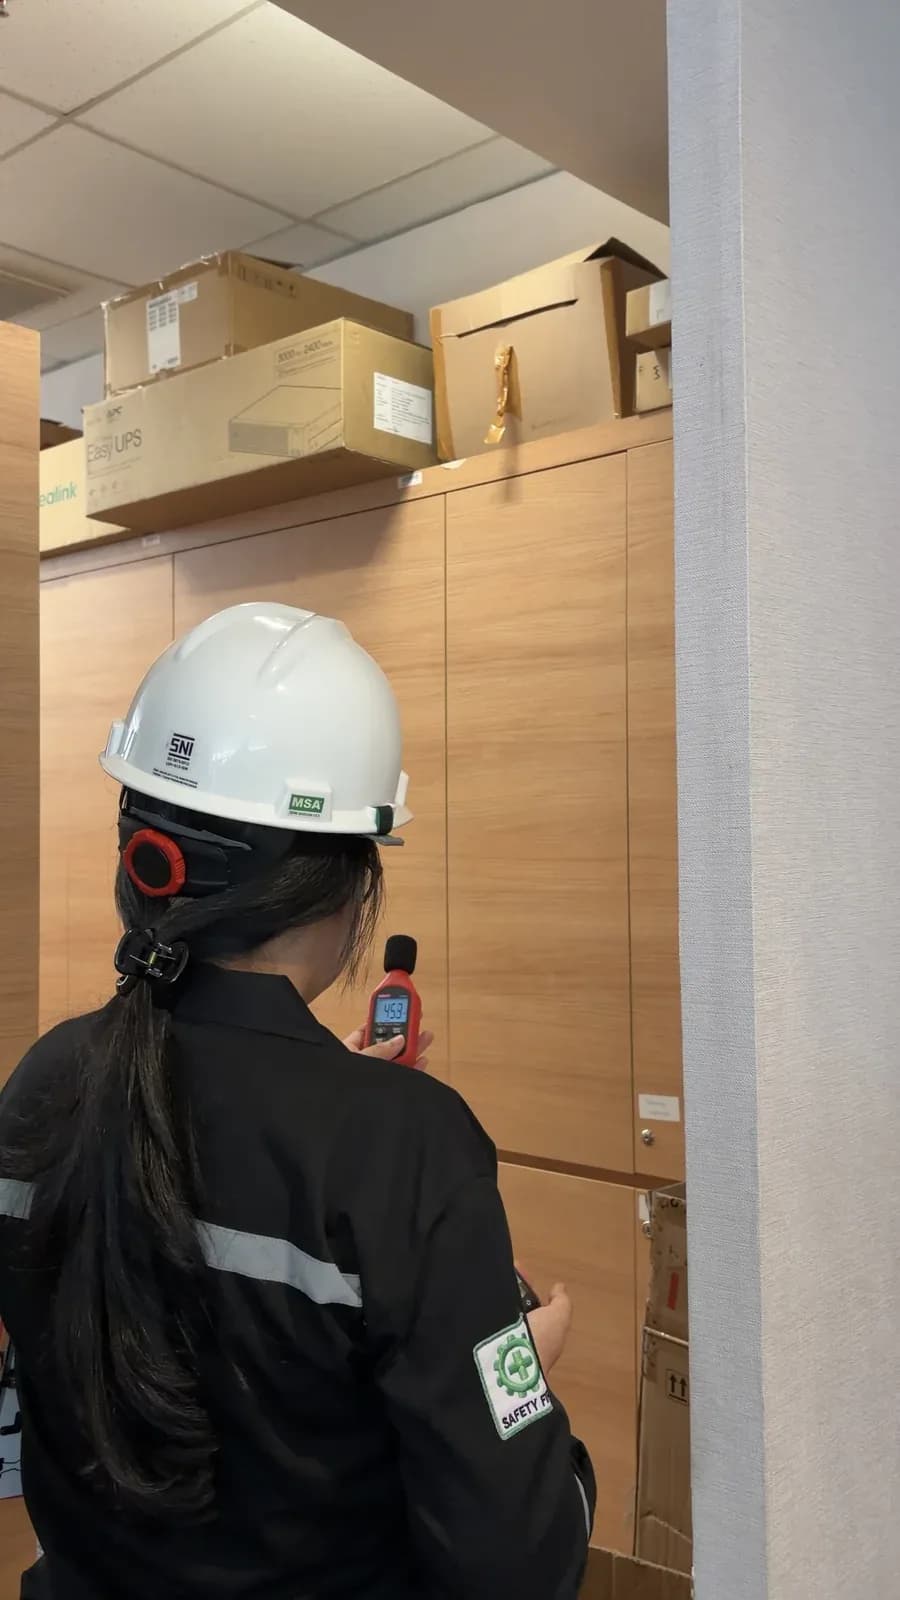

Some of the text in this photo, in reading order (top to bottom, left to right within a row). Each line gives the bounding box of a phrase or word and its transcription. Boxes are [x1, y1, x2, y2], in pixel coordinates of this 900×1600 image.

[87, 428, 142, 463] Easy UPS
[169, 738, 194, 756] SNI
[291, 796, 321, 810] MSA
[502, 1399, 539, 1429] SAFETY
